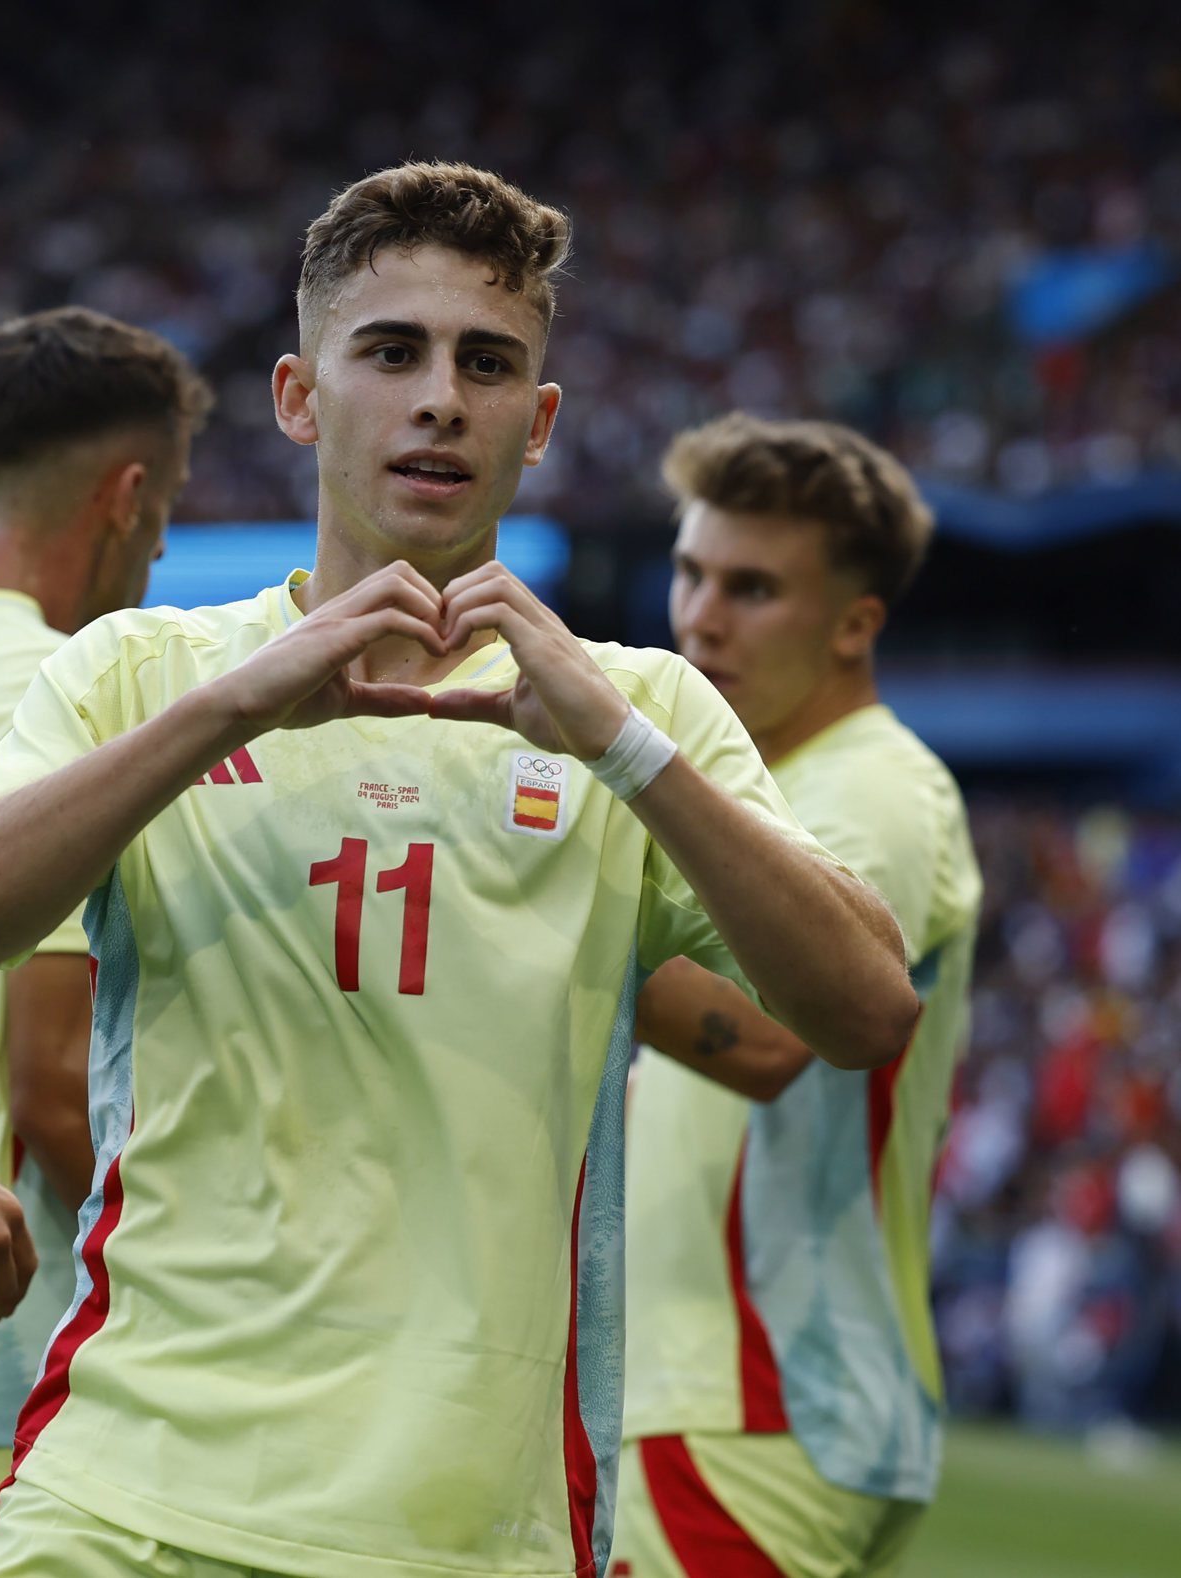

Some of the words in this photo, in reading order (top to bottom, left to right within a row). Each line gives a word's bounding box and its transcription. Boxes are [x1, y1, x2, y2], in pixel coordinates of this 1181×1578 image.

[359, 782, 388, 792] FRANCE
[398, 786, 419, 794] SPAIN
[357, 790, 367, 798] 09
[369, 792, 398, 801] AUGUST
[400, 795, 419, 803] 2024
[377, 801, 398, 809] PARIS
[309, 837, 434, 995] 11
